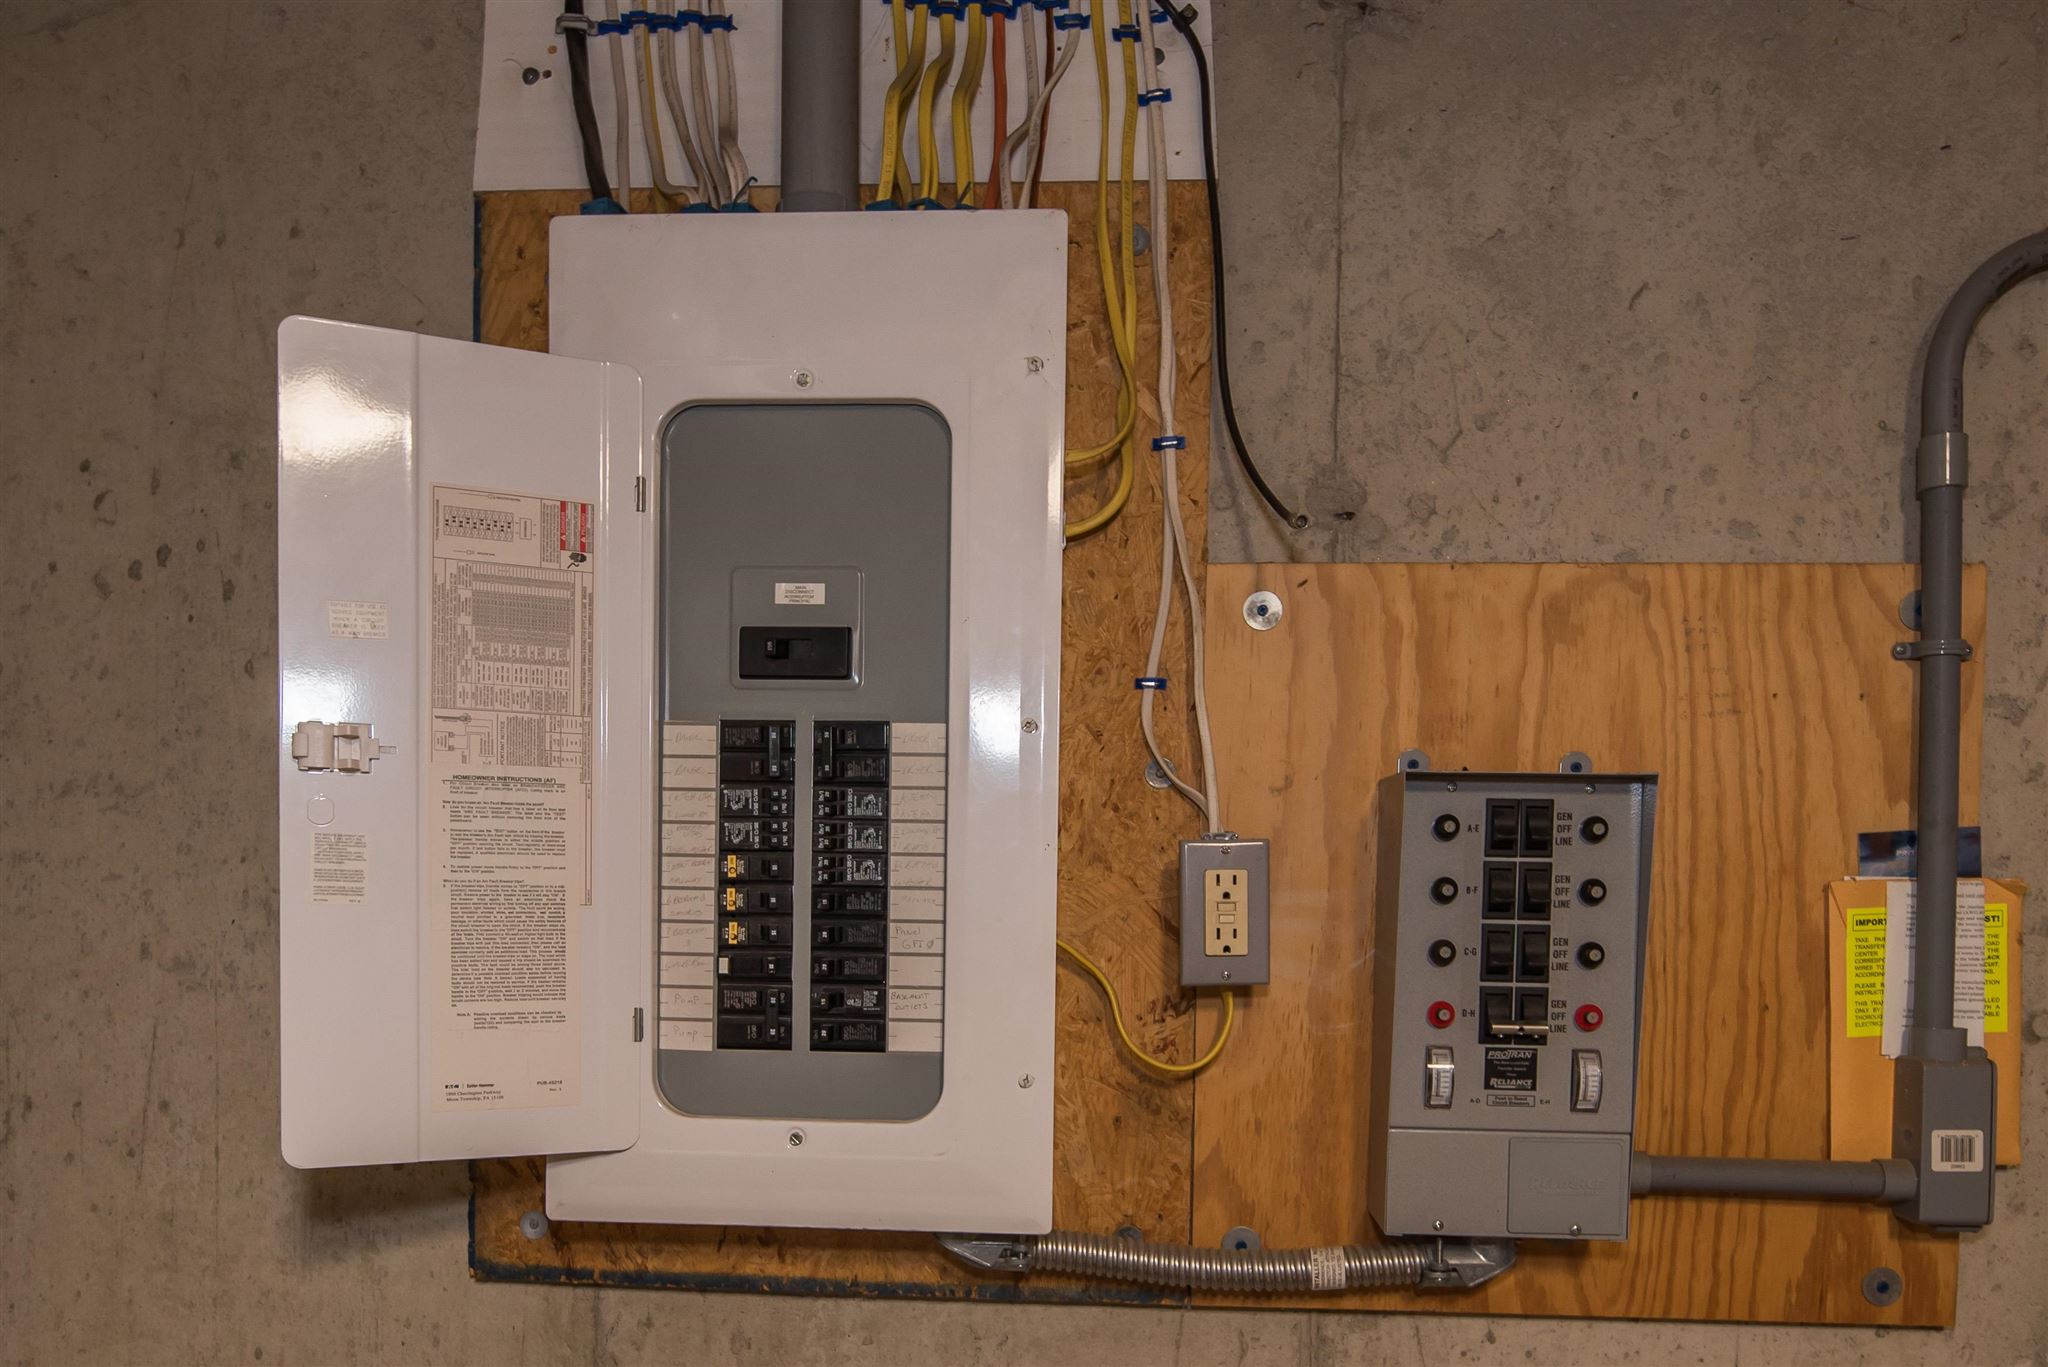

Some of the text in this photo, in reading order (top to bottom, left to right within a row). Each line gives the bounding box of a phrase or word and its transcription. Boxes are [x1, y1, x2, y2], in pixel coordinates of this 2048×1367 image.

[1555, 837, 1573, 846] LINE
[1555, 875, 1570, 883] GEN
[1553, 900, 1571, 908] LINE
[1553, 938, 1568, 946] GEN
[1551, 963, 1568, 971] LINE
[1550, 1025, 1567, 1033] LINE
[1490, 1078, 1532, 1088] RELIANCE
